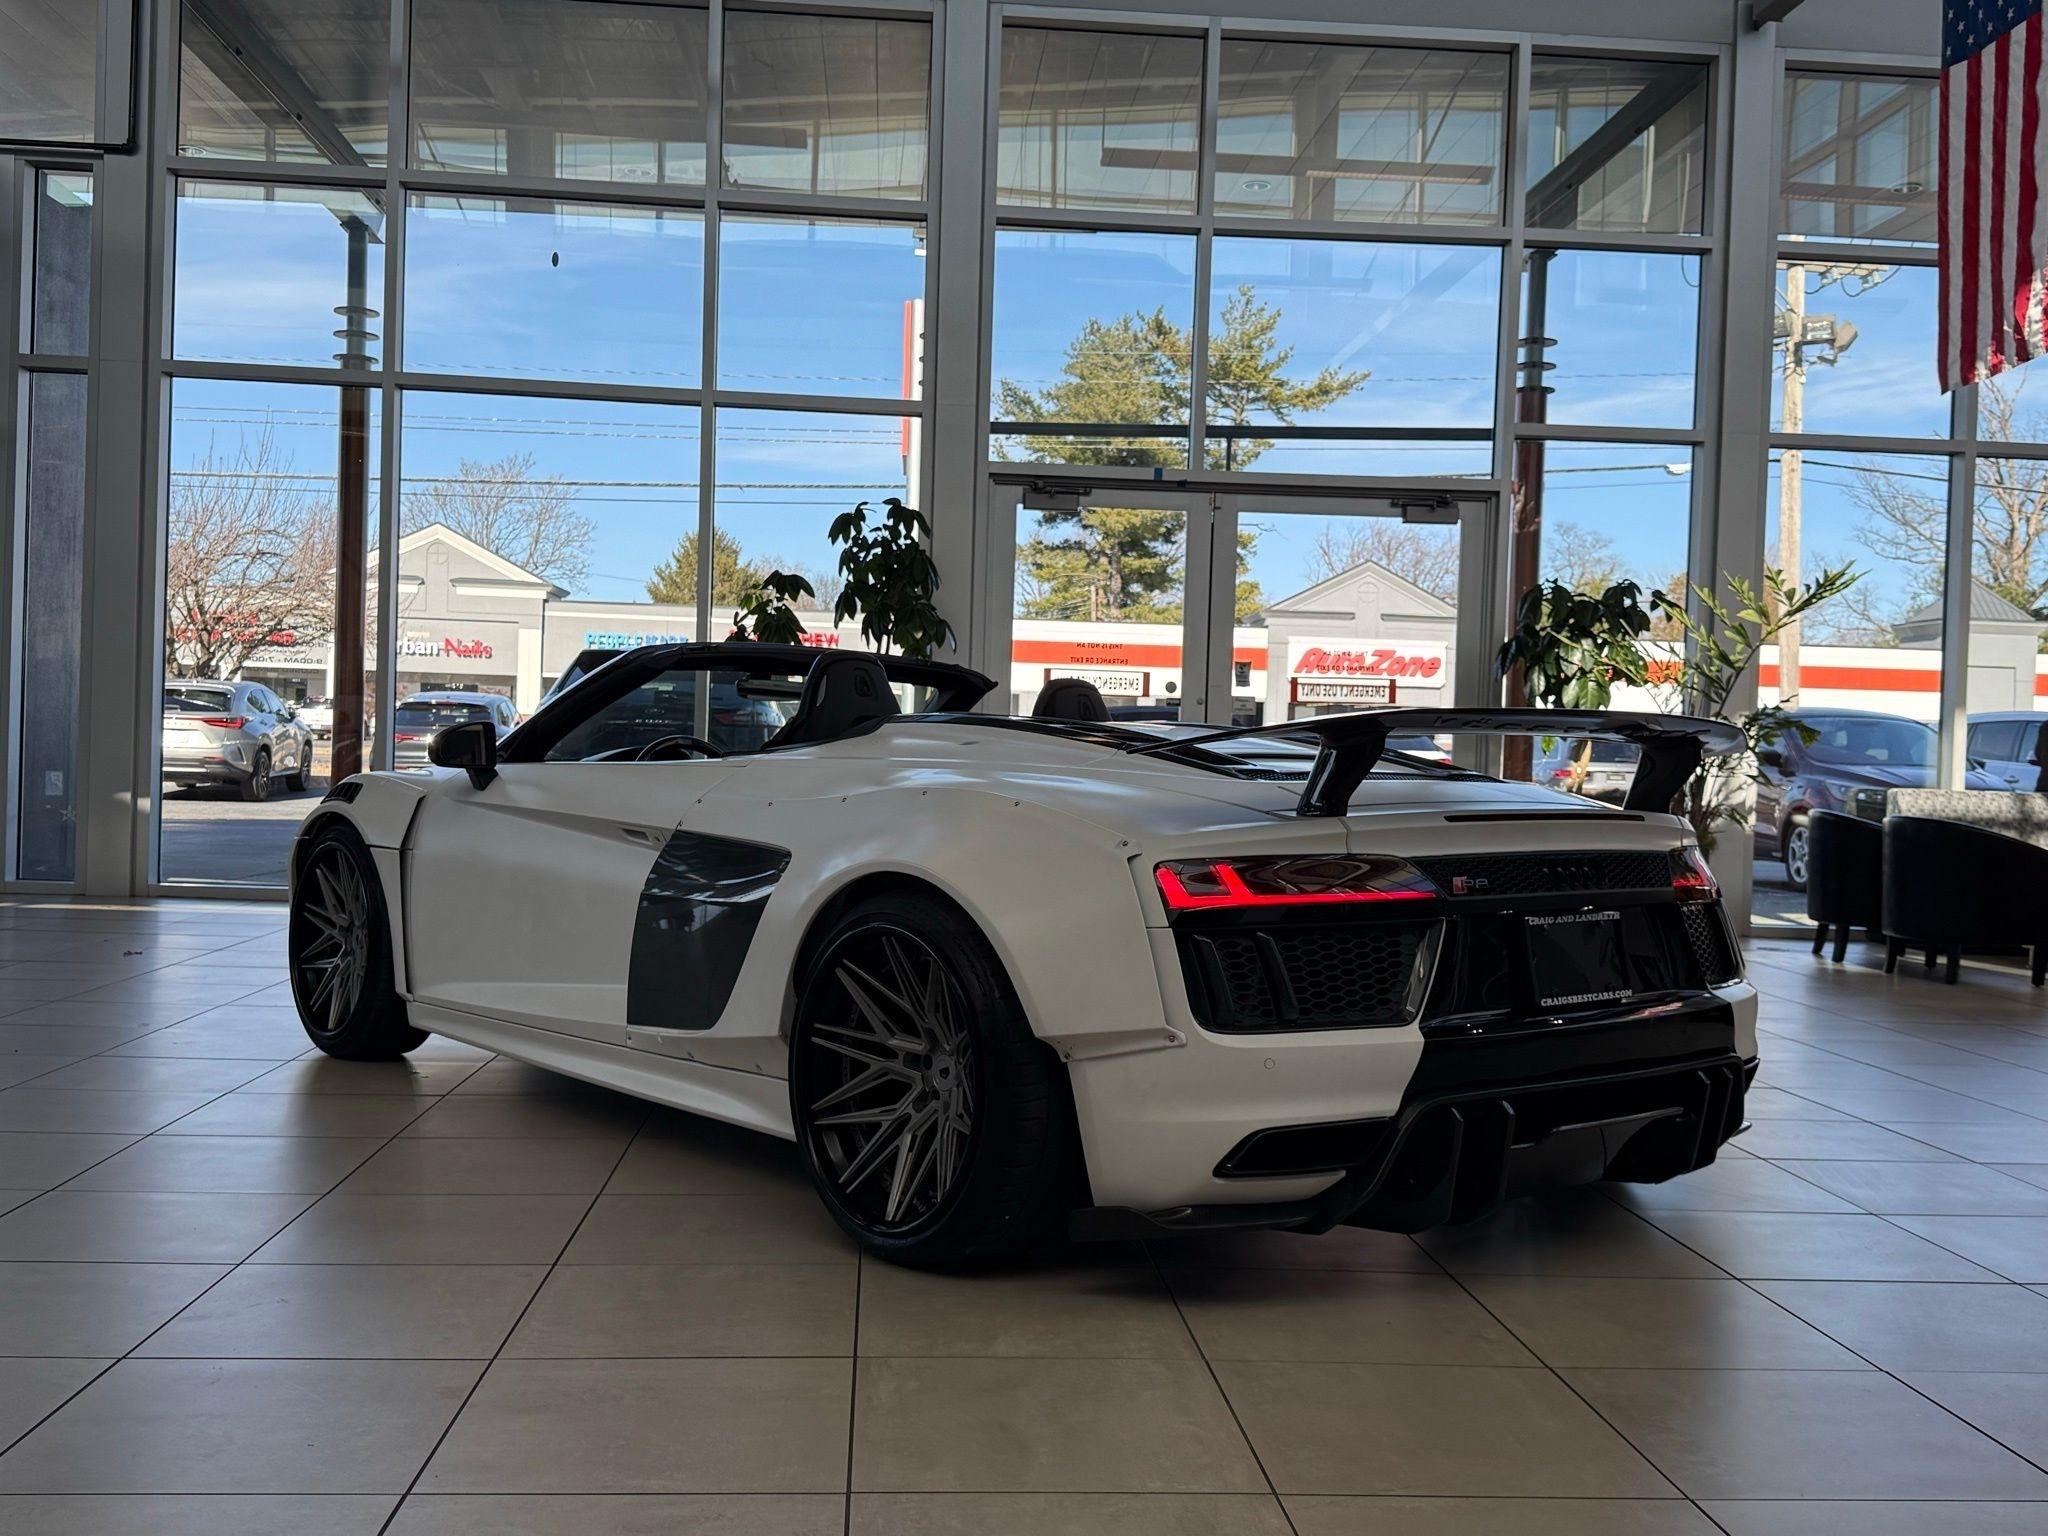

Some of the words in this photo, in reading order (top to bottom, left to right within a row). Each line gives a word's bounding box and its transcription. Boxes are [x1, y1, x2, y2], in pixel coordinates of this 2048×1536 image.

[396, 636, 439, 656] rban
[444, 638, 492, 659] Nails
[1294, 647, 1442, 678] AutoZone
[1528, 916, 1555, 925] CRAIG
[1555, 914, 1575, 924] AND
[1575, 911, 1621, 922] LANDRETH
[1540, 989, 1633, 1007] CRAIGSBESTCARS.COM
